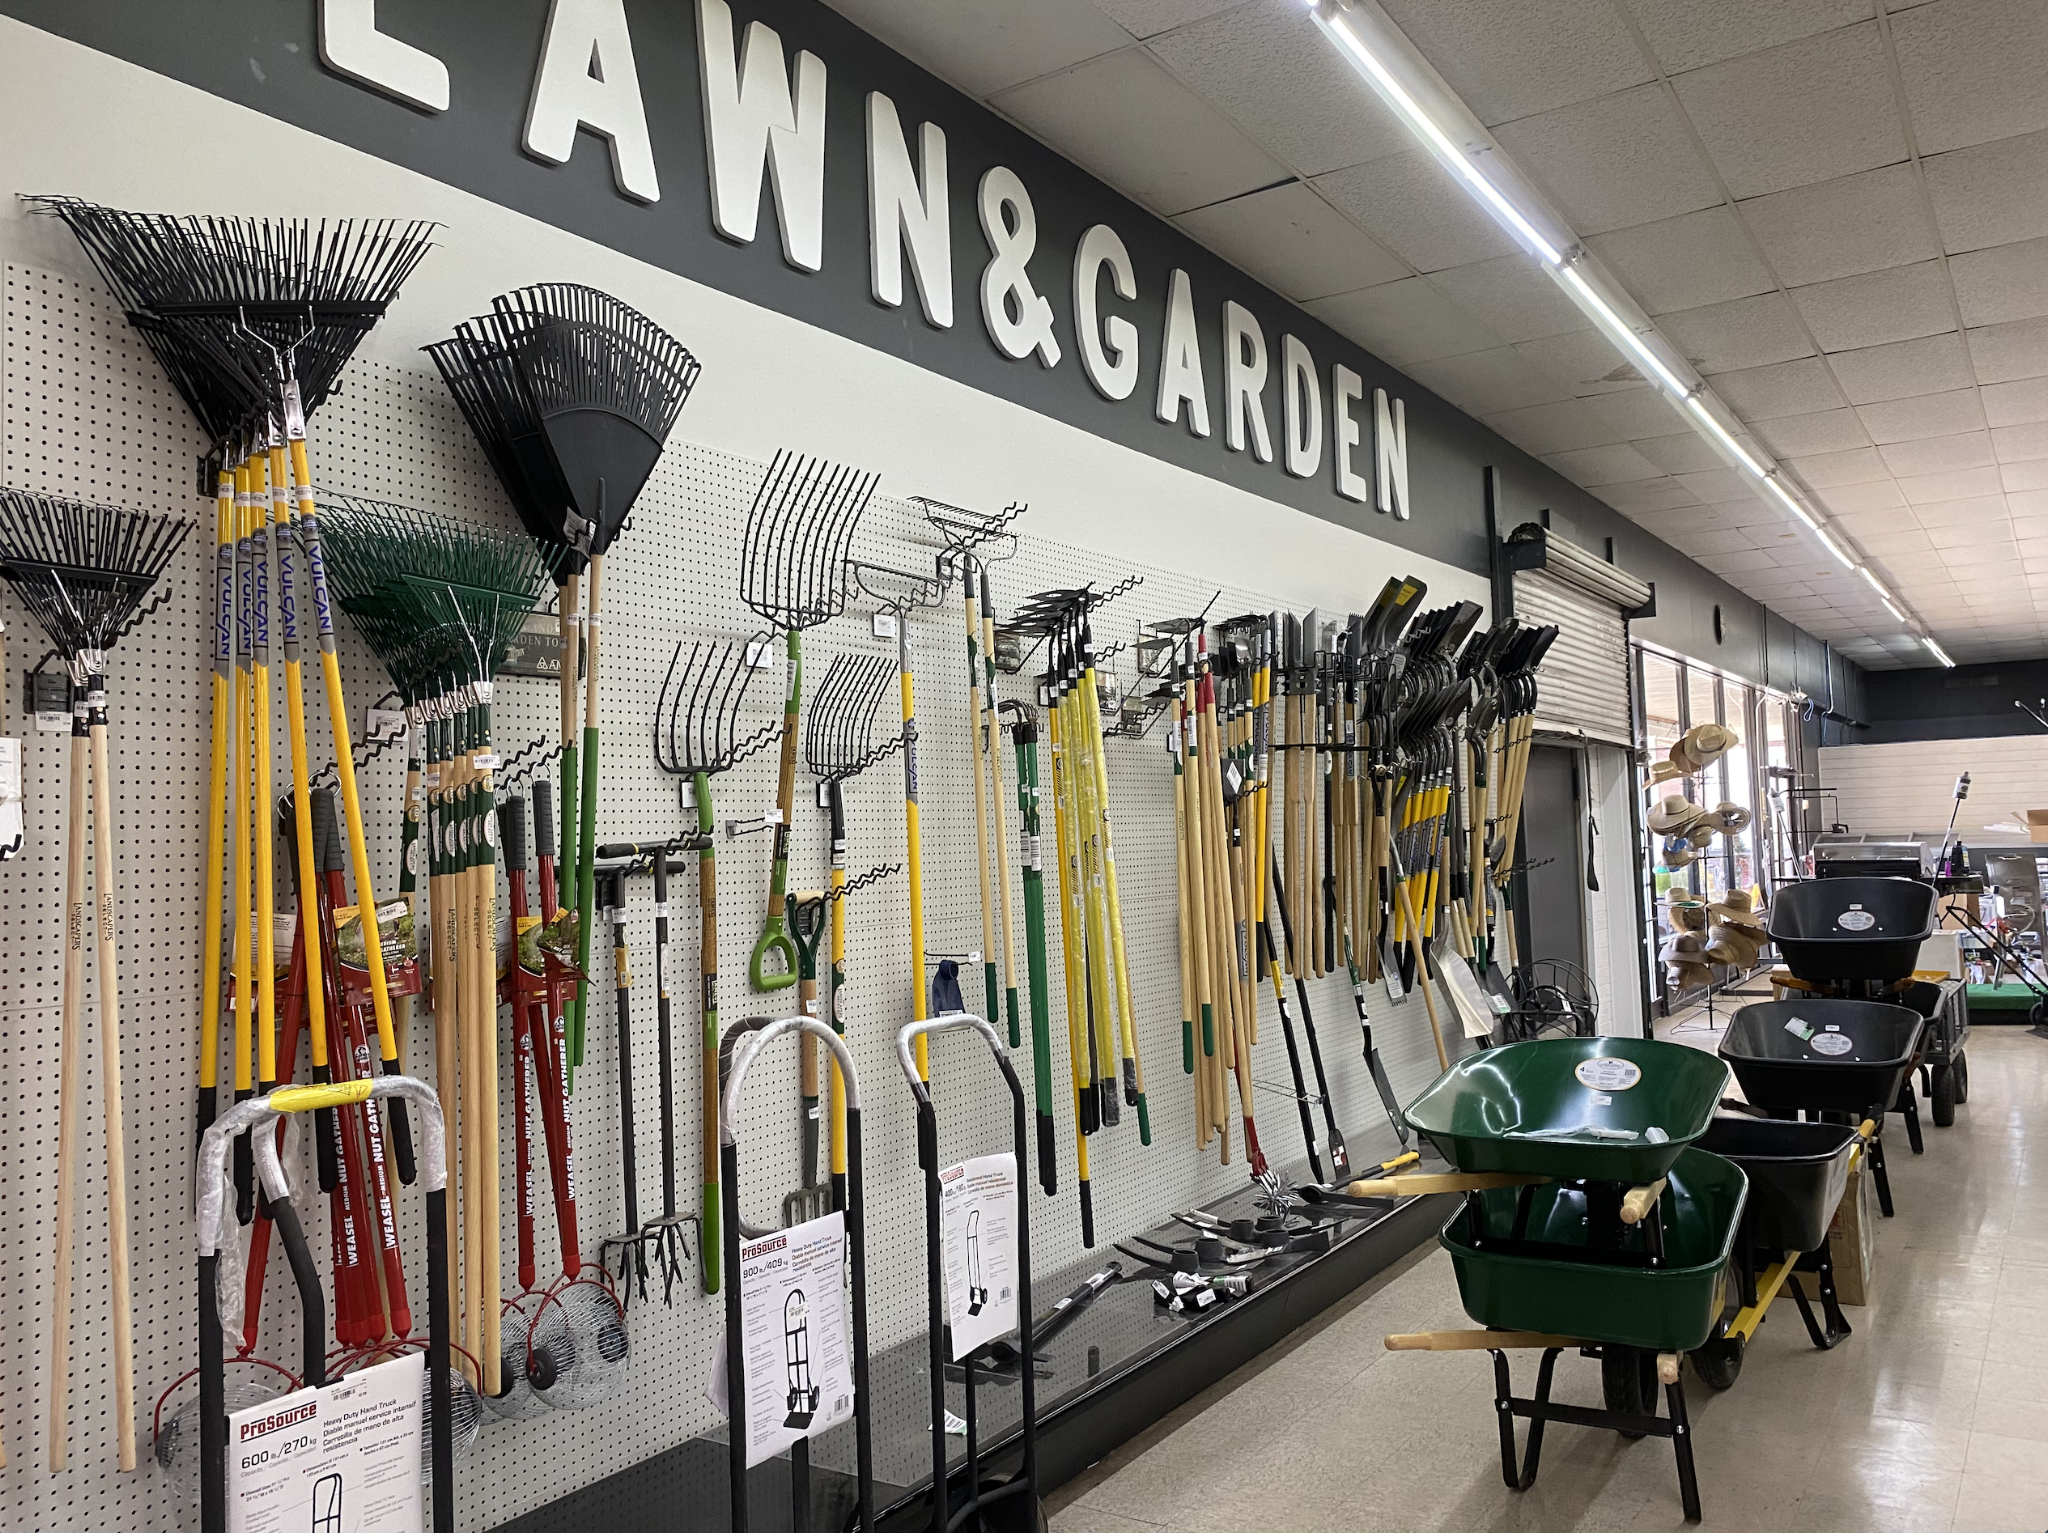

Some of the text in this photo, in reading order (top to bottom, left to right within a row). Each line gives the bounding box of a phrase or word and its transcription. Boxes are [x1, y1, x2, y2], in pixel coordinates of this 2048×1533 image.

[253, 560, 268, 642] VULCAN
[281, 554, 297, 639] VULCAN
[308, 545, 331, 629] VULCAN
[72, 902, 82, 950] LANDSCAPERS
[104, 893, 114, 941] LANDSCAPERS
[559, 1038, 569, 1096] GATHERER
[563, 1099, 571, 1122] NUT
[371, 1135, 384, 1162] NUT
[336, 1157, 348, 1183] NUT
[376, 1164, 387, 1191] MEDIUM
[566, 1153, 576, 1200] WEASEL
[343, 1185, 351, 1211] MEDIUM
[525, 1170, 534, 1215] WEASEL
[378, 1195, 398, 1249] WEASEL
[343, 1214, 359, 1267] WEASEL
[742, 1237, 787, 1259] ProSource
[743, 1265, 759, 1279] 900
[241, 1404, 317, 1440] ProSource
[323, 1398, 397, 1428] Heavy Duty Hand Truck
[323, 1400, 416, 1437] Diable manuel service intensif
[354, 1428, 362, 1436] de
[363, 1422, 381, 1432] mano
[382, 1418, 390, 1426] de
[391, 1414, 404, 1423] alta
[241, 1450, 269, 1469] 600
[310, 1438, 317, 1446] kg
[323, 1437, 358, 1454] resistencia
